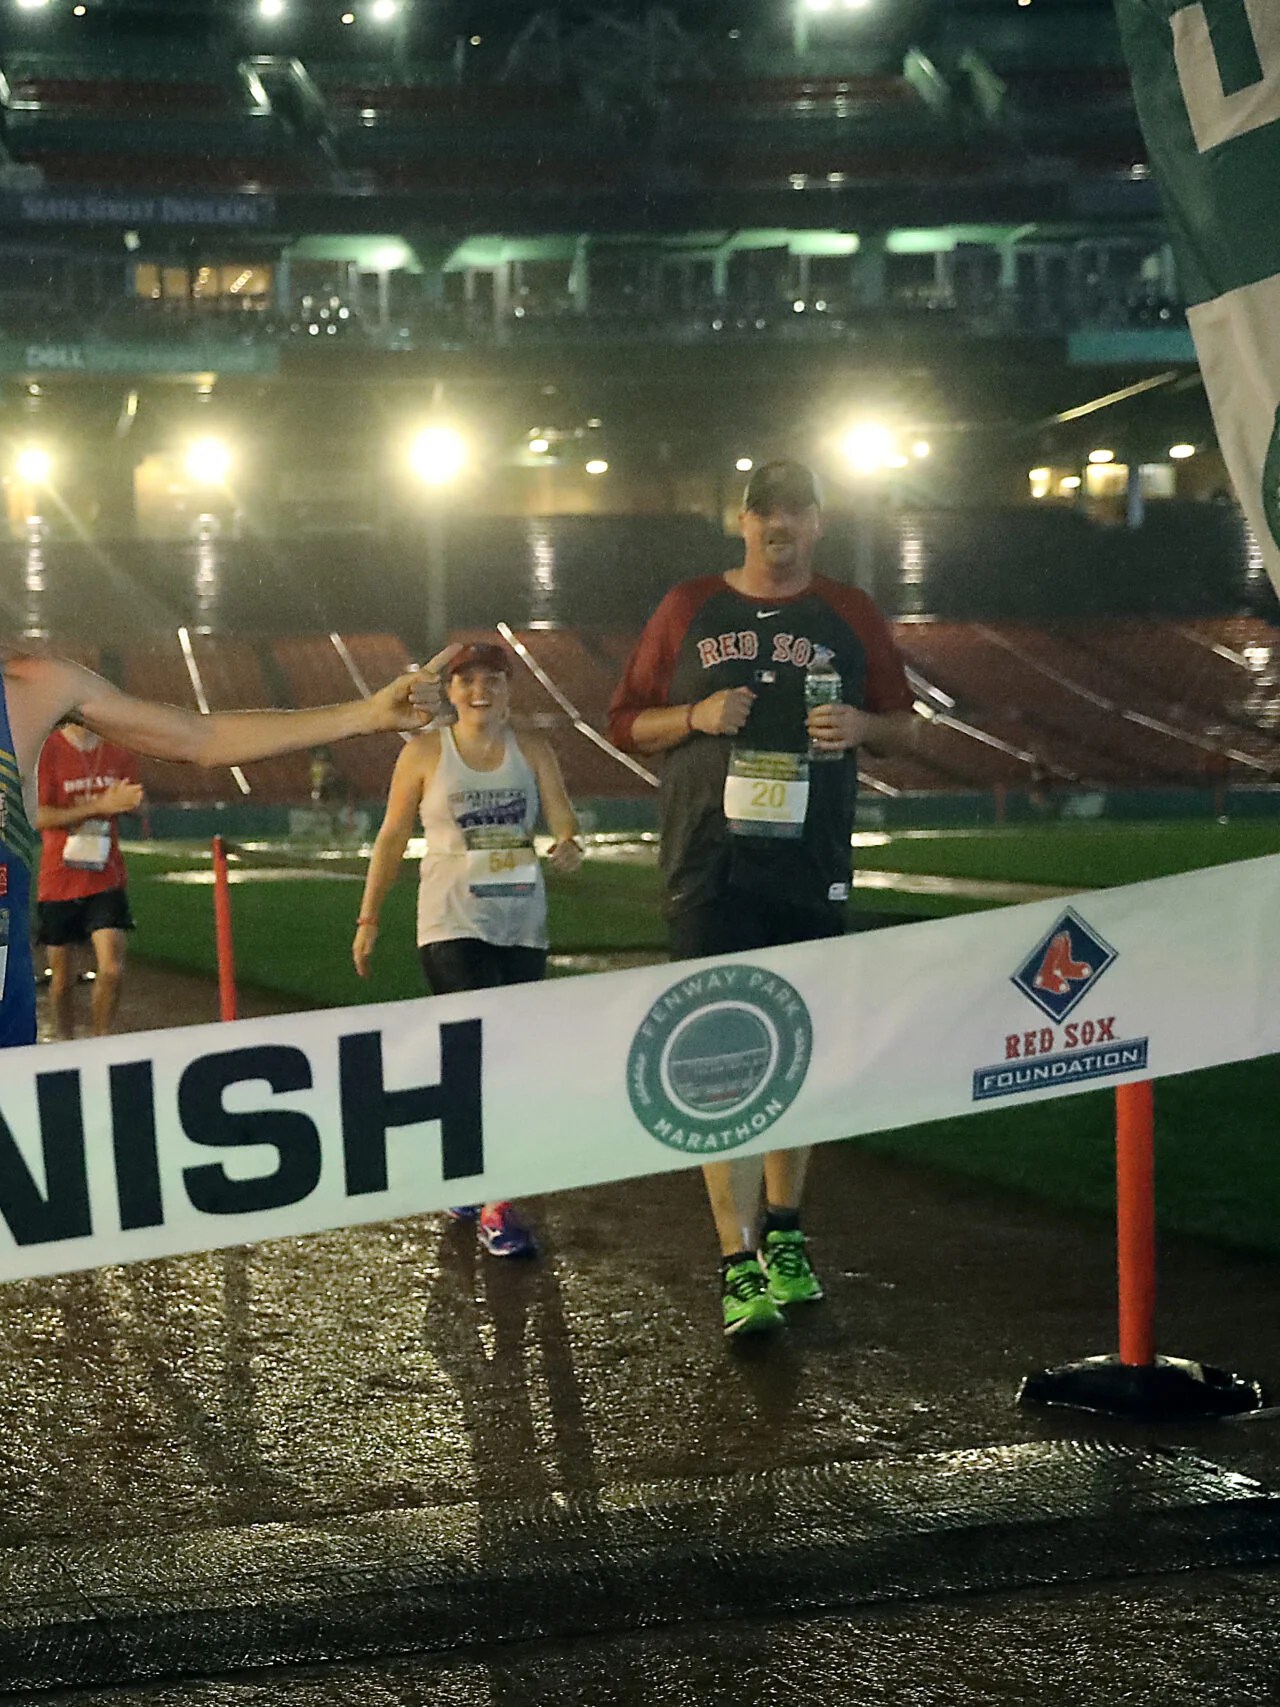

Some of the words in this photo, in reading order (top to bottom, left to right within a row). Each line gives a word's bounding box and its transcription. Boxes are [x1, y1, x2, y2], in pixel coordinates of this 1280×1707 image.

[697, 631, 758, 668] RED
[772, 633, 815, 668] SO
[751, 781, 787, 808] 20
[489, 851, 517, 873] 54
[641, 969, 737, 1038] FENWAY
[748, 972, 801, 1017] PARK
[1005, 1027, 1055, 1061] RED
[1064, 1016, 1117, 1049] SOX
[982, 1049, 1139, 1091] FOUNDATION
[643, 1099, 783, 1149] MARATHON
